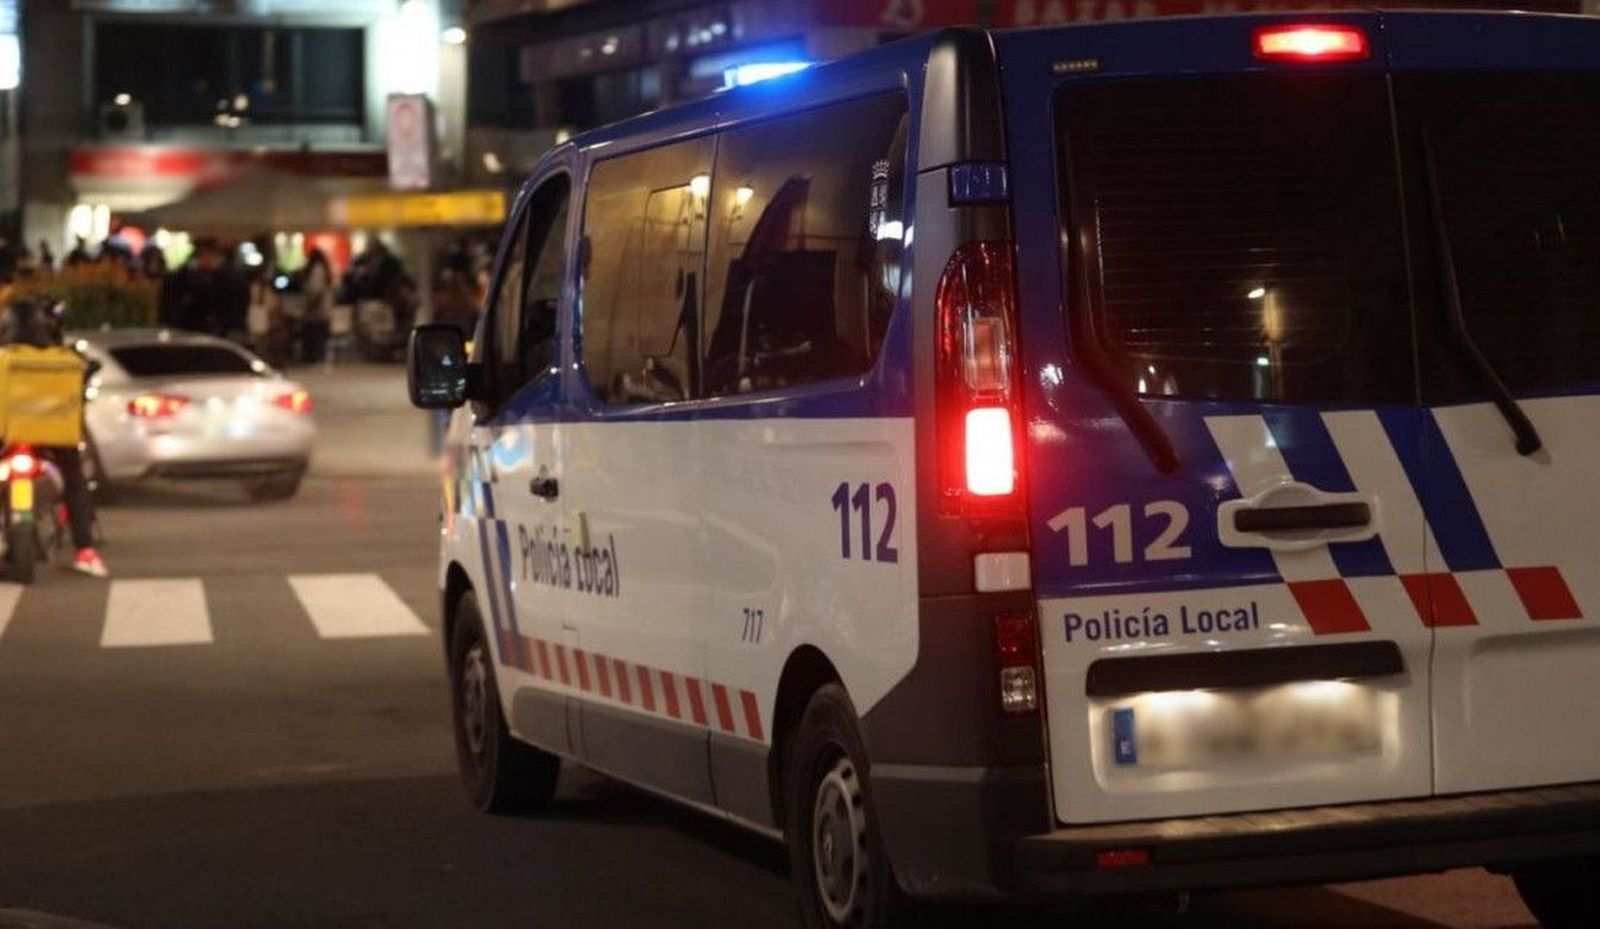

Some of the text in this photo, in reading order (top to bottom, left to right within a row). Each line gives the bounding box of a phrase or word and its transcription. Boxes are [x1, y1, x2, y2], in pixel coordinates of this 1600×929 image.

[831, 481, 899, 564] 112
[1046, 500, 1192, 567] 112
[742, 607, 764, 643] 717
[1063, 601, 1259, 643] Policía Local
